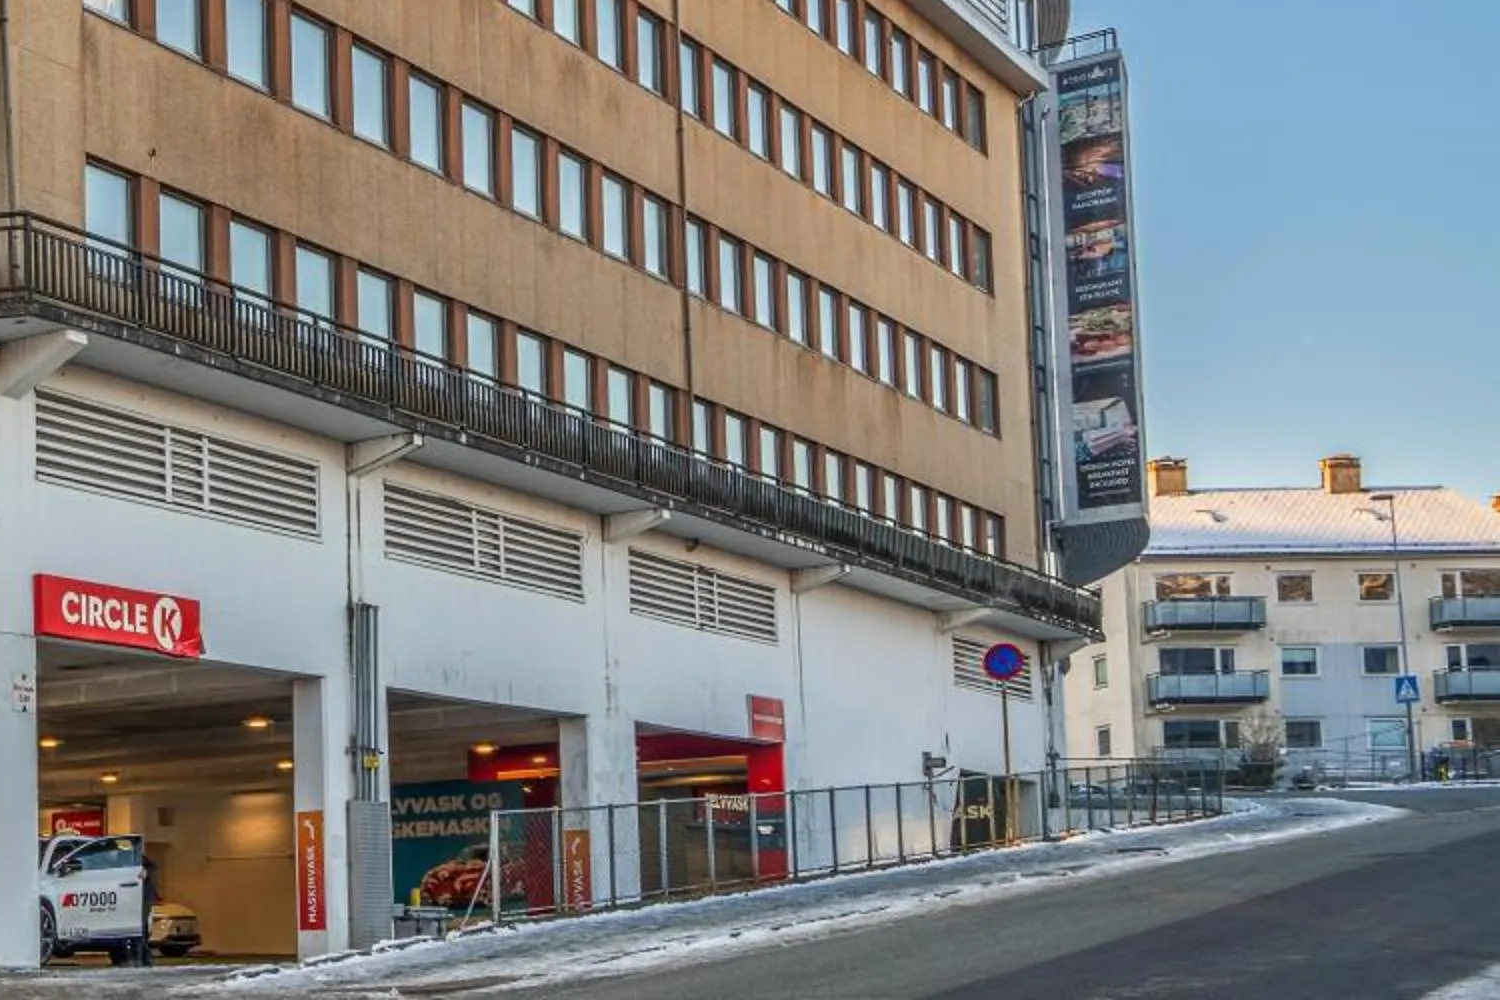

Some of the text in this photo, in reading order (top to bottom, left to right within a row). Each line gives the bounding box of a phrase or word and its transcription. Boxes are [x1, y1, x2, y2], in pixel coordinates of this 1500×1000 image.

[61, 590, 181, 645] CIRCLE K
[470, 792, 503, 810] OG
[71, 891, 117, 908] 07000
